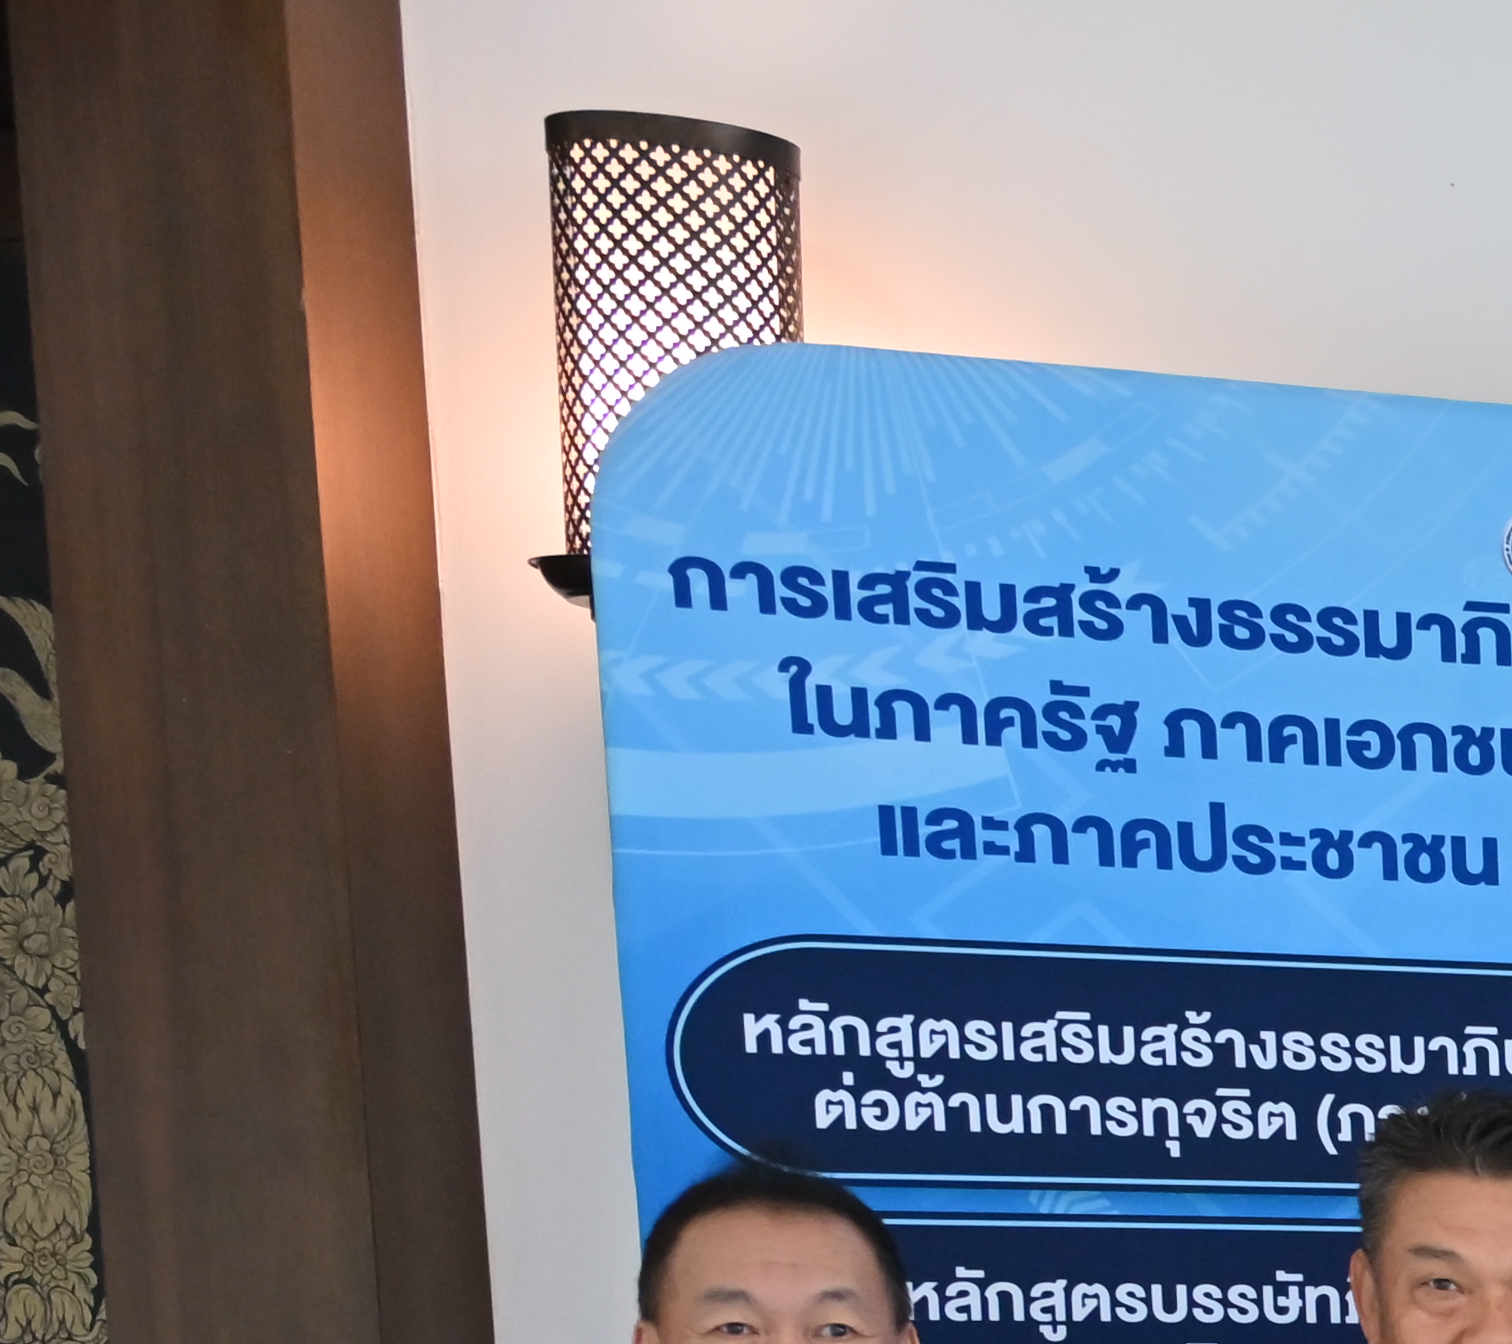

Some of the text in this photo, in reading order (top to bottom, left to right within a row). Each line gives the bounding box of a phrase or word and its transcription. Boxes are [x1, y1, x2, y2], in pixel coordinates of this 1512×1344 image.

[777, 655, 1140, 774] ในภาครัฐ
[877, 800, 1500, 887] และภาคประชาชน
[813, 1070, 1297, 1158] ต่อต้านการทุจริต
[906, 1265, 1360, 1342] หลักสูตรบรรษัท
